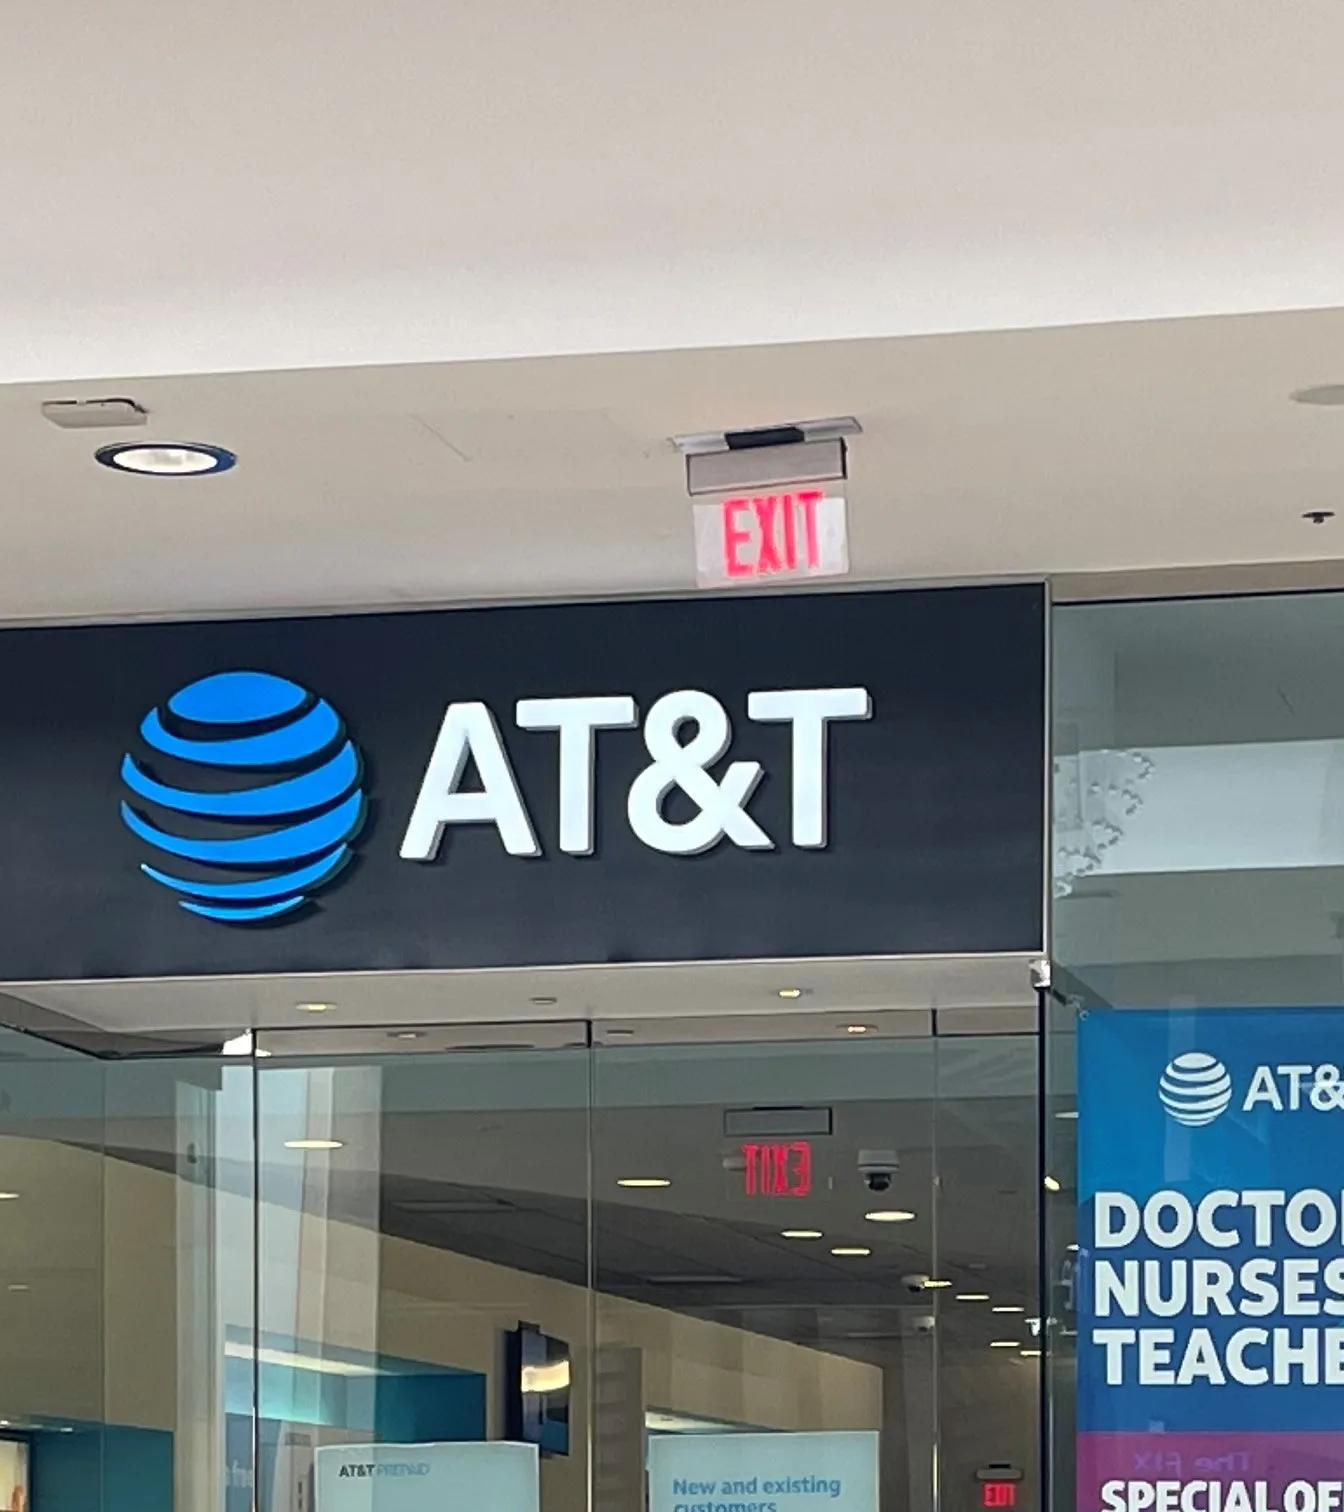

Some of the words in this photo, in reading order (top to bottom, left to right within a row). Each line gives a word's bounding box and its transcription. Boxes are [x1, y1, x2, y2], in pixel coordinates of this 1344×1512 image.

[722, 488, 822, 577] EXIT
[400, 686, 872, 860] AT&T
[338, 1464, 376, 1478] AT&T
[672, 1479, 716, 1496] New
[721, 1476, 758, 1495] and
[762, 1474, 842, 1499] existing
